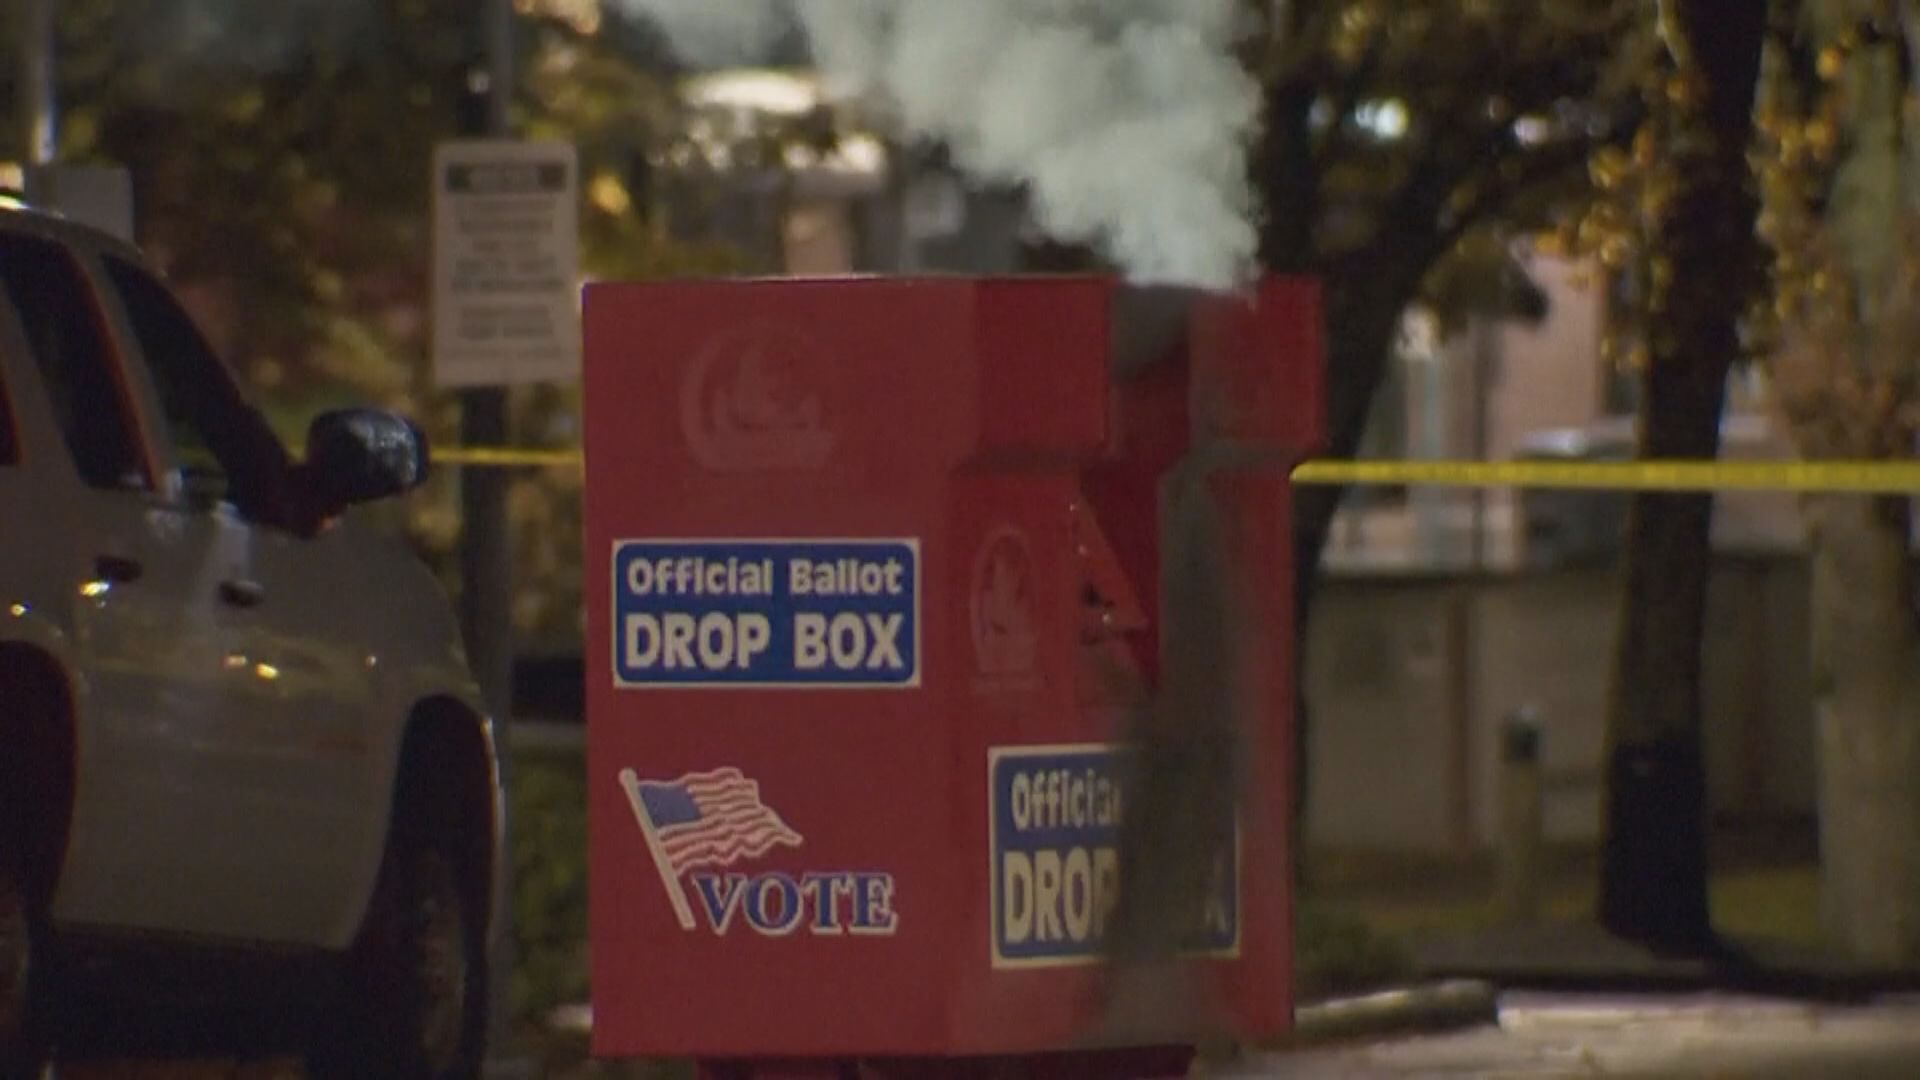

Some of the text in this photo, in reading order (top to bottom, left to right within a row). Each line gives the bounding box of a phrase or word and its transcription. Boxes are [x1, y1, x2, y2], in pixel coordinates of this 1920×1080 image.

[627, 557, 903, 595] Official Ballot
[624, 612, 904, 669] DROP BOX
[692, 871, 898, 936] VOTE
